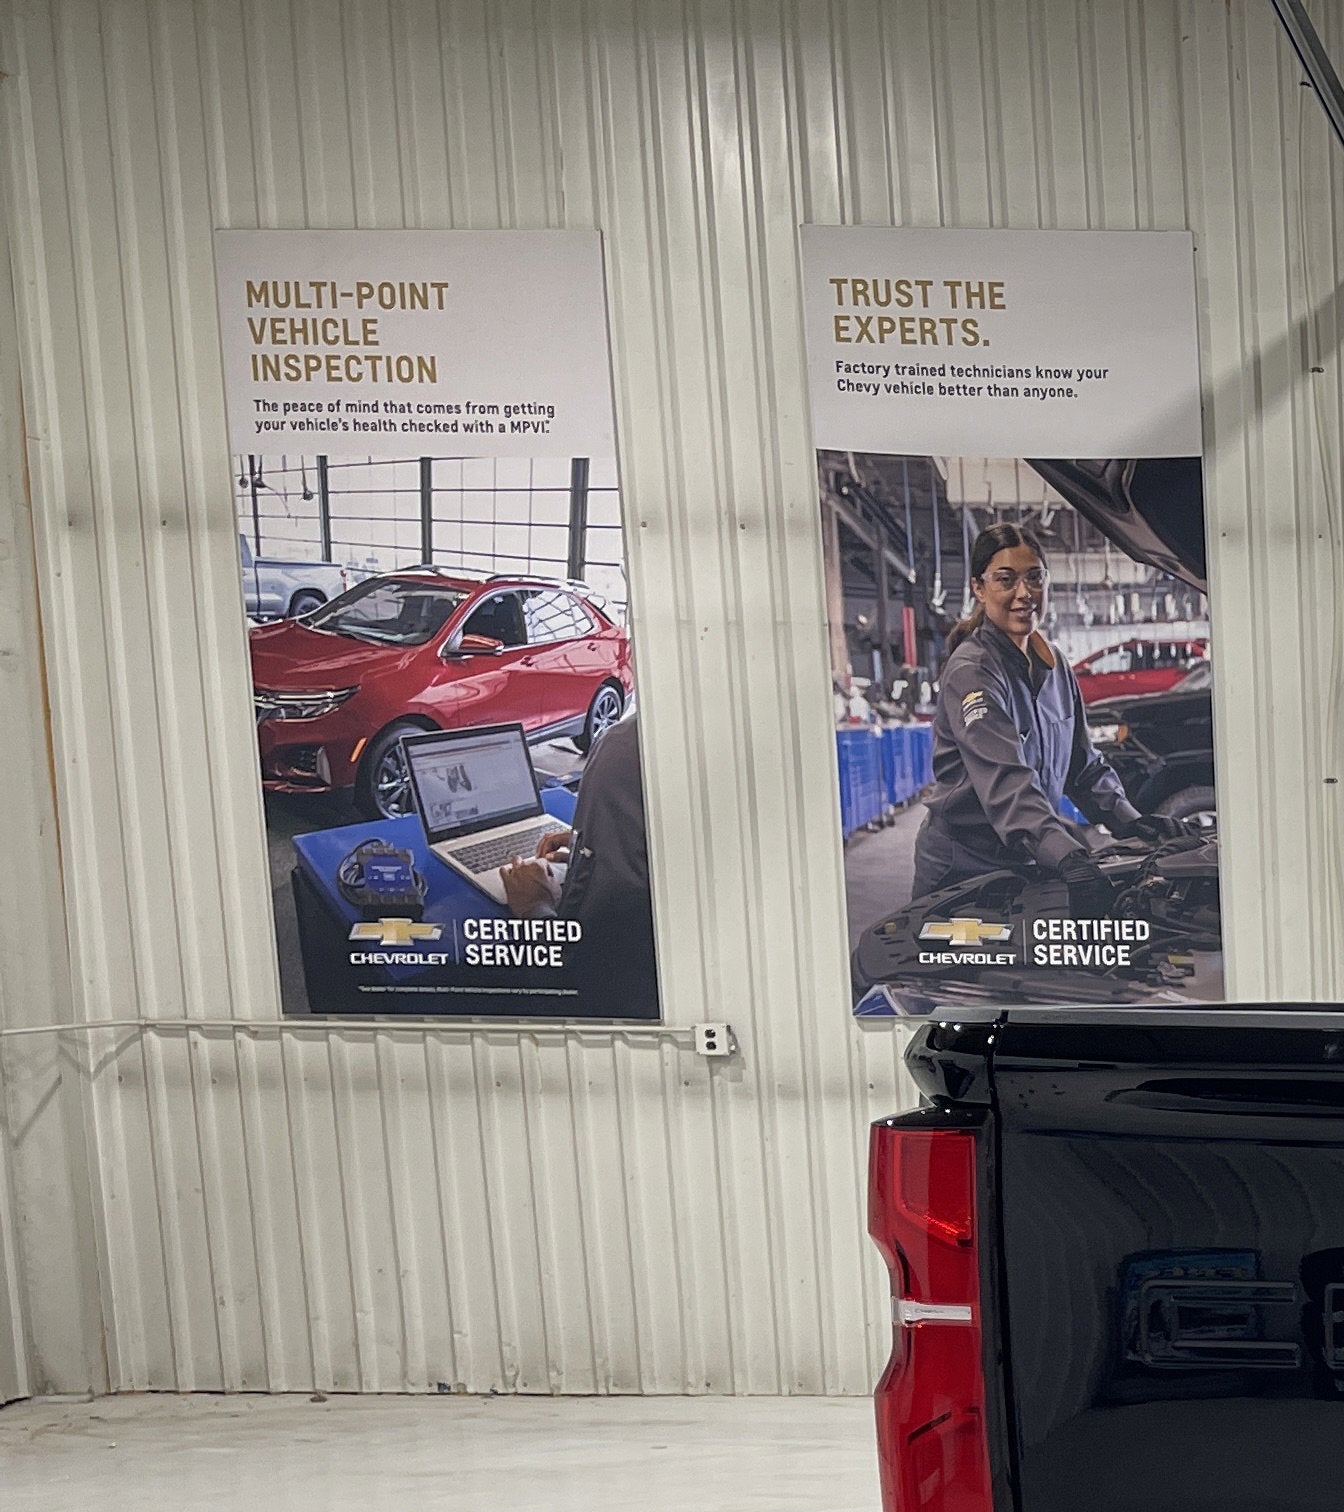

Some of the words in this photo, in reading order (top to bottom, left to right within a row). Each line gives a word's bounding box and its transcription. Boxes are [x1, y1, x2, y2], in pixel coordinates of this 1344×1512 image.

[246, 280, 448, 310] MULTI-POINT
[829, 278, 934, 309] TRUST
[943, 280, 1007, 310] THE
[247, 317, 380, 346] VEHICLE
[833, 315, 991, 347] EXPERTS.
[251, 354, 437, 383] INSPECTION
[835, 360, 891, 378] Factory
[894, 363, 947, 378] trained
[950, 364, 1032, 380] technicians
[1035, 365, 1074, 380] know
[1076, 367, 1109, 381] your
[836, 379, 881, 396] Chevy
[883, 380, 934, 396] vehicle
[938, 382, 984, 397] better
[987, 383, 1019, 398] than
[1022, 386, 1079, 401] anyone.
[253, 399, 279, 413] The
[283, 402, 323, 416] peace
[327, 400, 341, 413] of
[345, 400, 379, 414] mind
[383, 401, 412, 415] that
[416, 404, 461, 416] comes
[465, 401, 499, 415] from
[503, 402, 555, 418] getting
[255, 421, 286, 433] your
[290, 417, 349, 432] vehicle's
[353, 418, 398, 432] health
[401, 419, 459, 433] checked
[462, 419, 495, 433] with
[498, 423, 507, 434] a
[463, 918, 582, 942] CERTIFIED
[1032, 918, 1150, 942] CERTIFIED
[349, 952, 449, 966] CHEVROLET
[465, 944, 564, 967] SERVICE
[918, 952, 1017, 966] CHEVROLET
[1033, 944, 1131, 967] SERVICE
